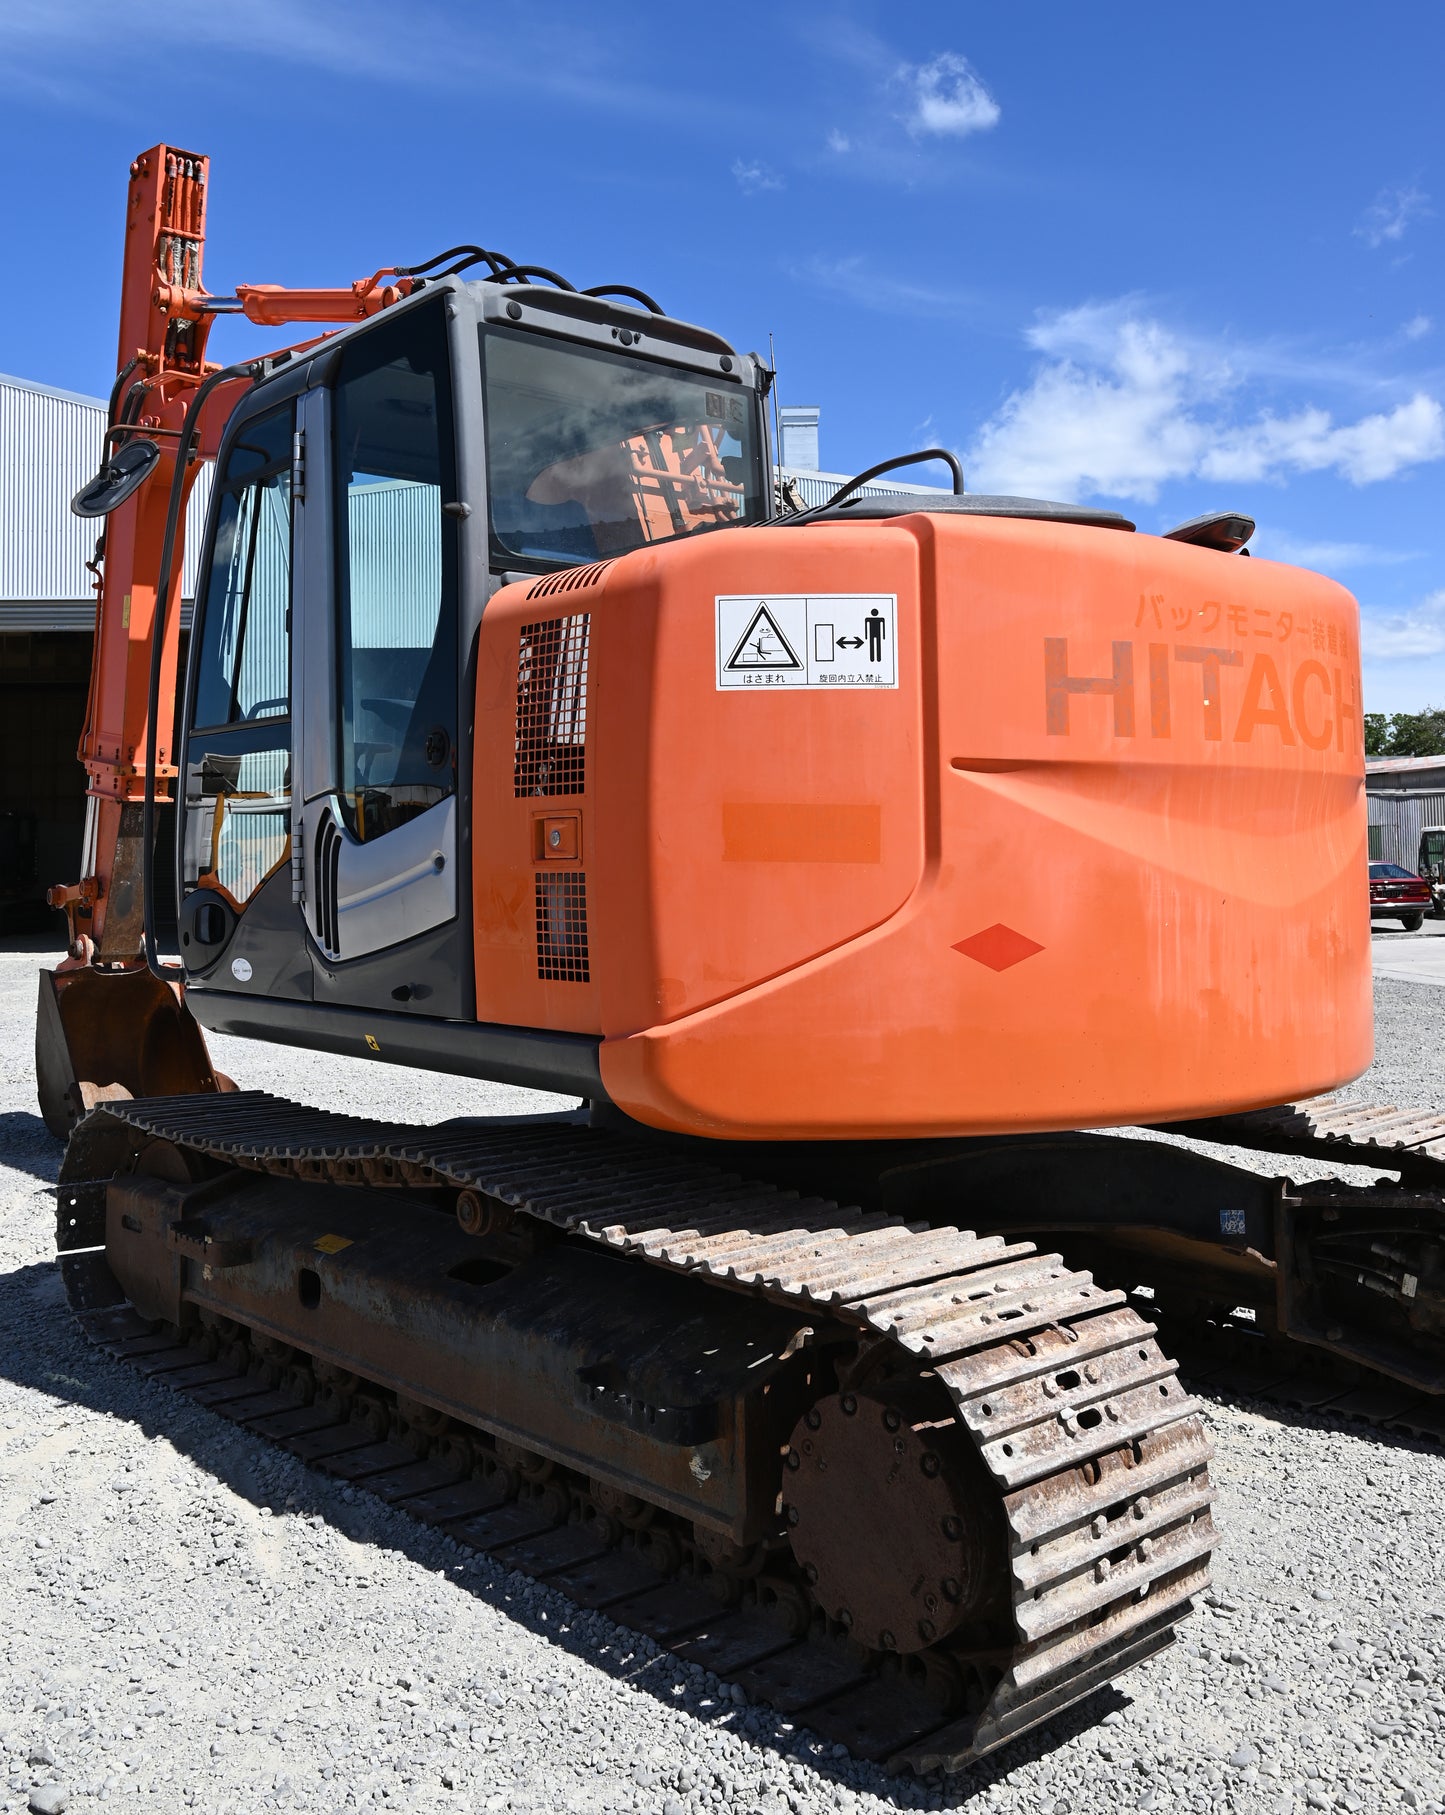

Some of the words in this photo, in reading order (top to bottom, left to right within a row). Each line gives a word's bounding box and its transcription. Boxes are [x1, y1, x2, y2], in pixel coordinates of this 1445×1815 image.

[743, 673, 786, 684] はさまれ
[819, 674, 883, 684] 旋回内立入禁止
[1043, 637, 1361, 756] HITACH
